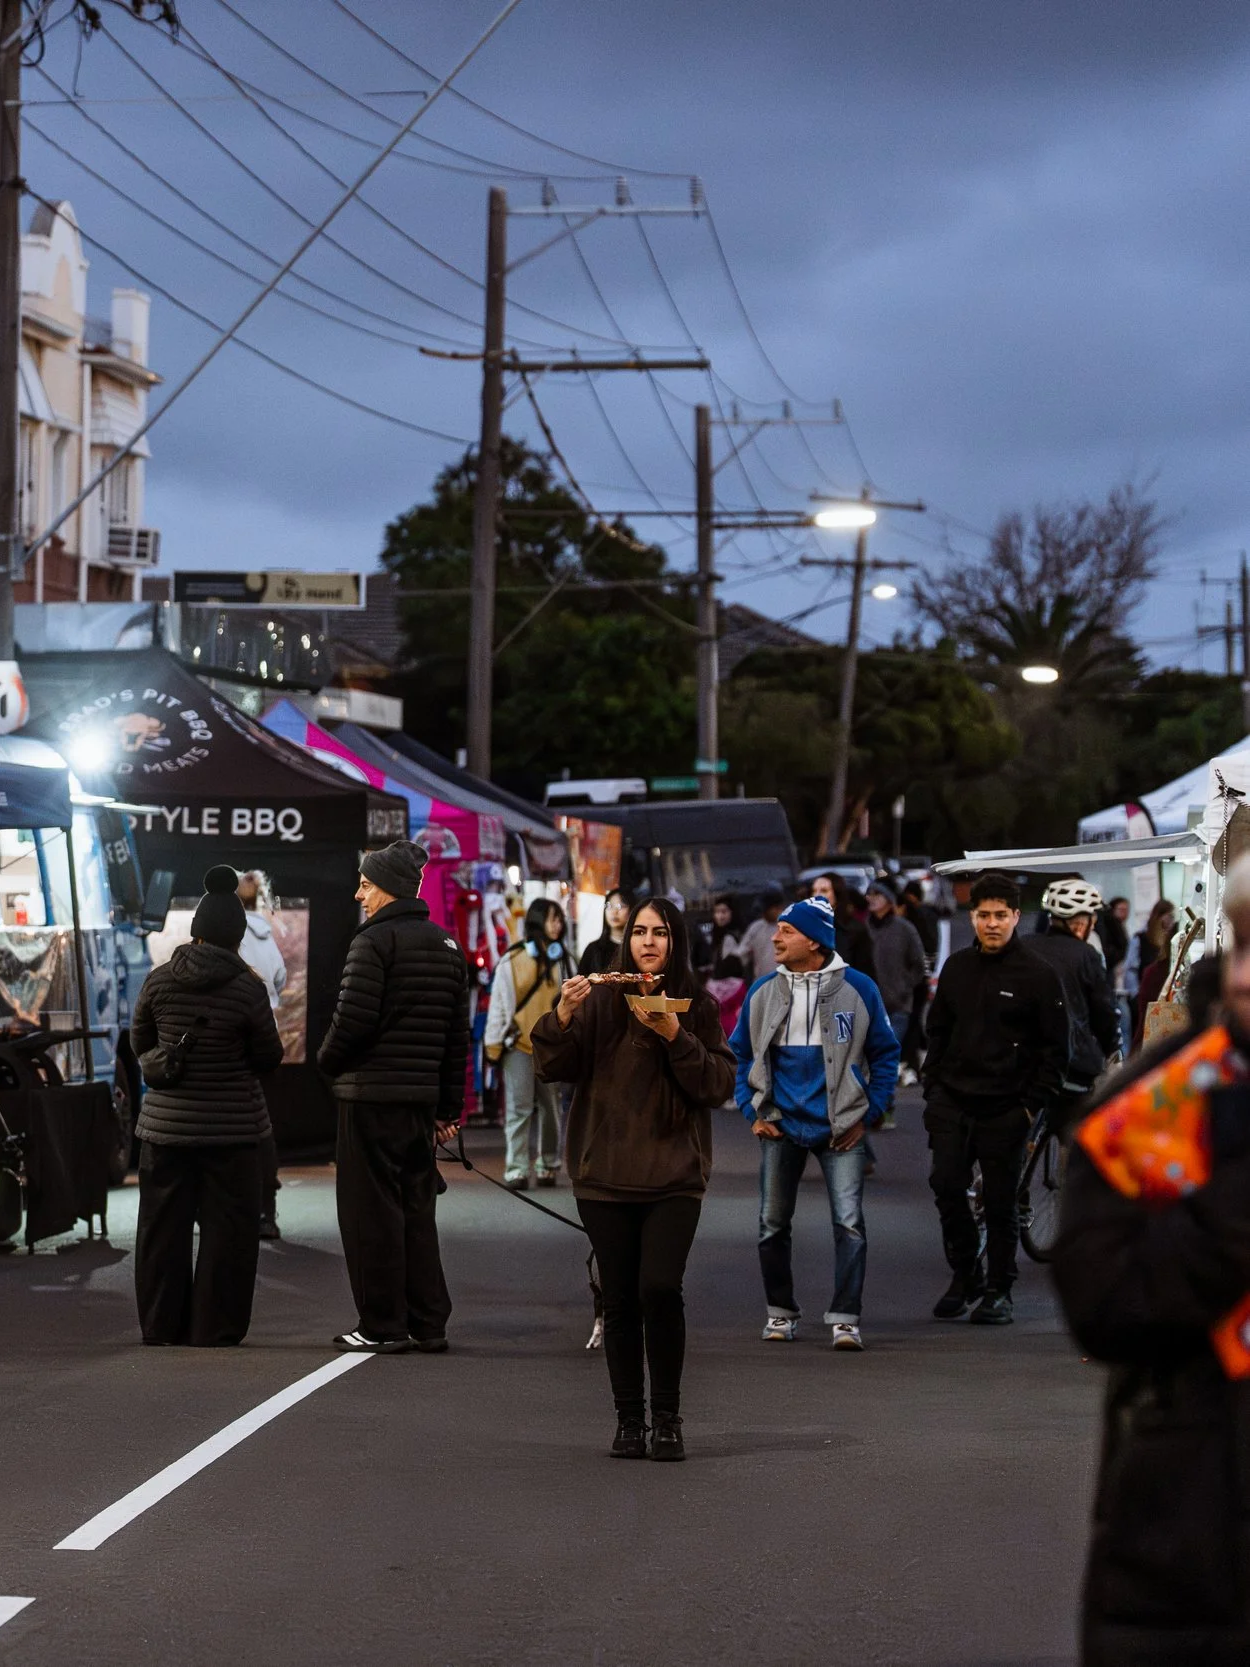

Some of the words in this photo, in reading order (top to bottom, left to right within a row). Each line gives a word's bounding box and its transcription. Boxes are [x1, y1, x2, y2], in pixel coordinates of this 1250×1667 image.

[141, 688, 183, 709] PIT
[179, 709, 214, 741] BBQ
[231, 807, 305, 843] BBQ
[834, 1011, 855, 1043] N
